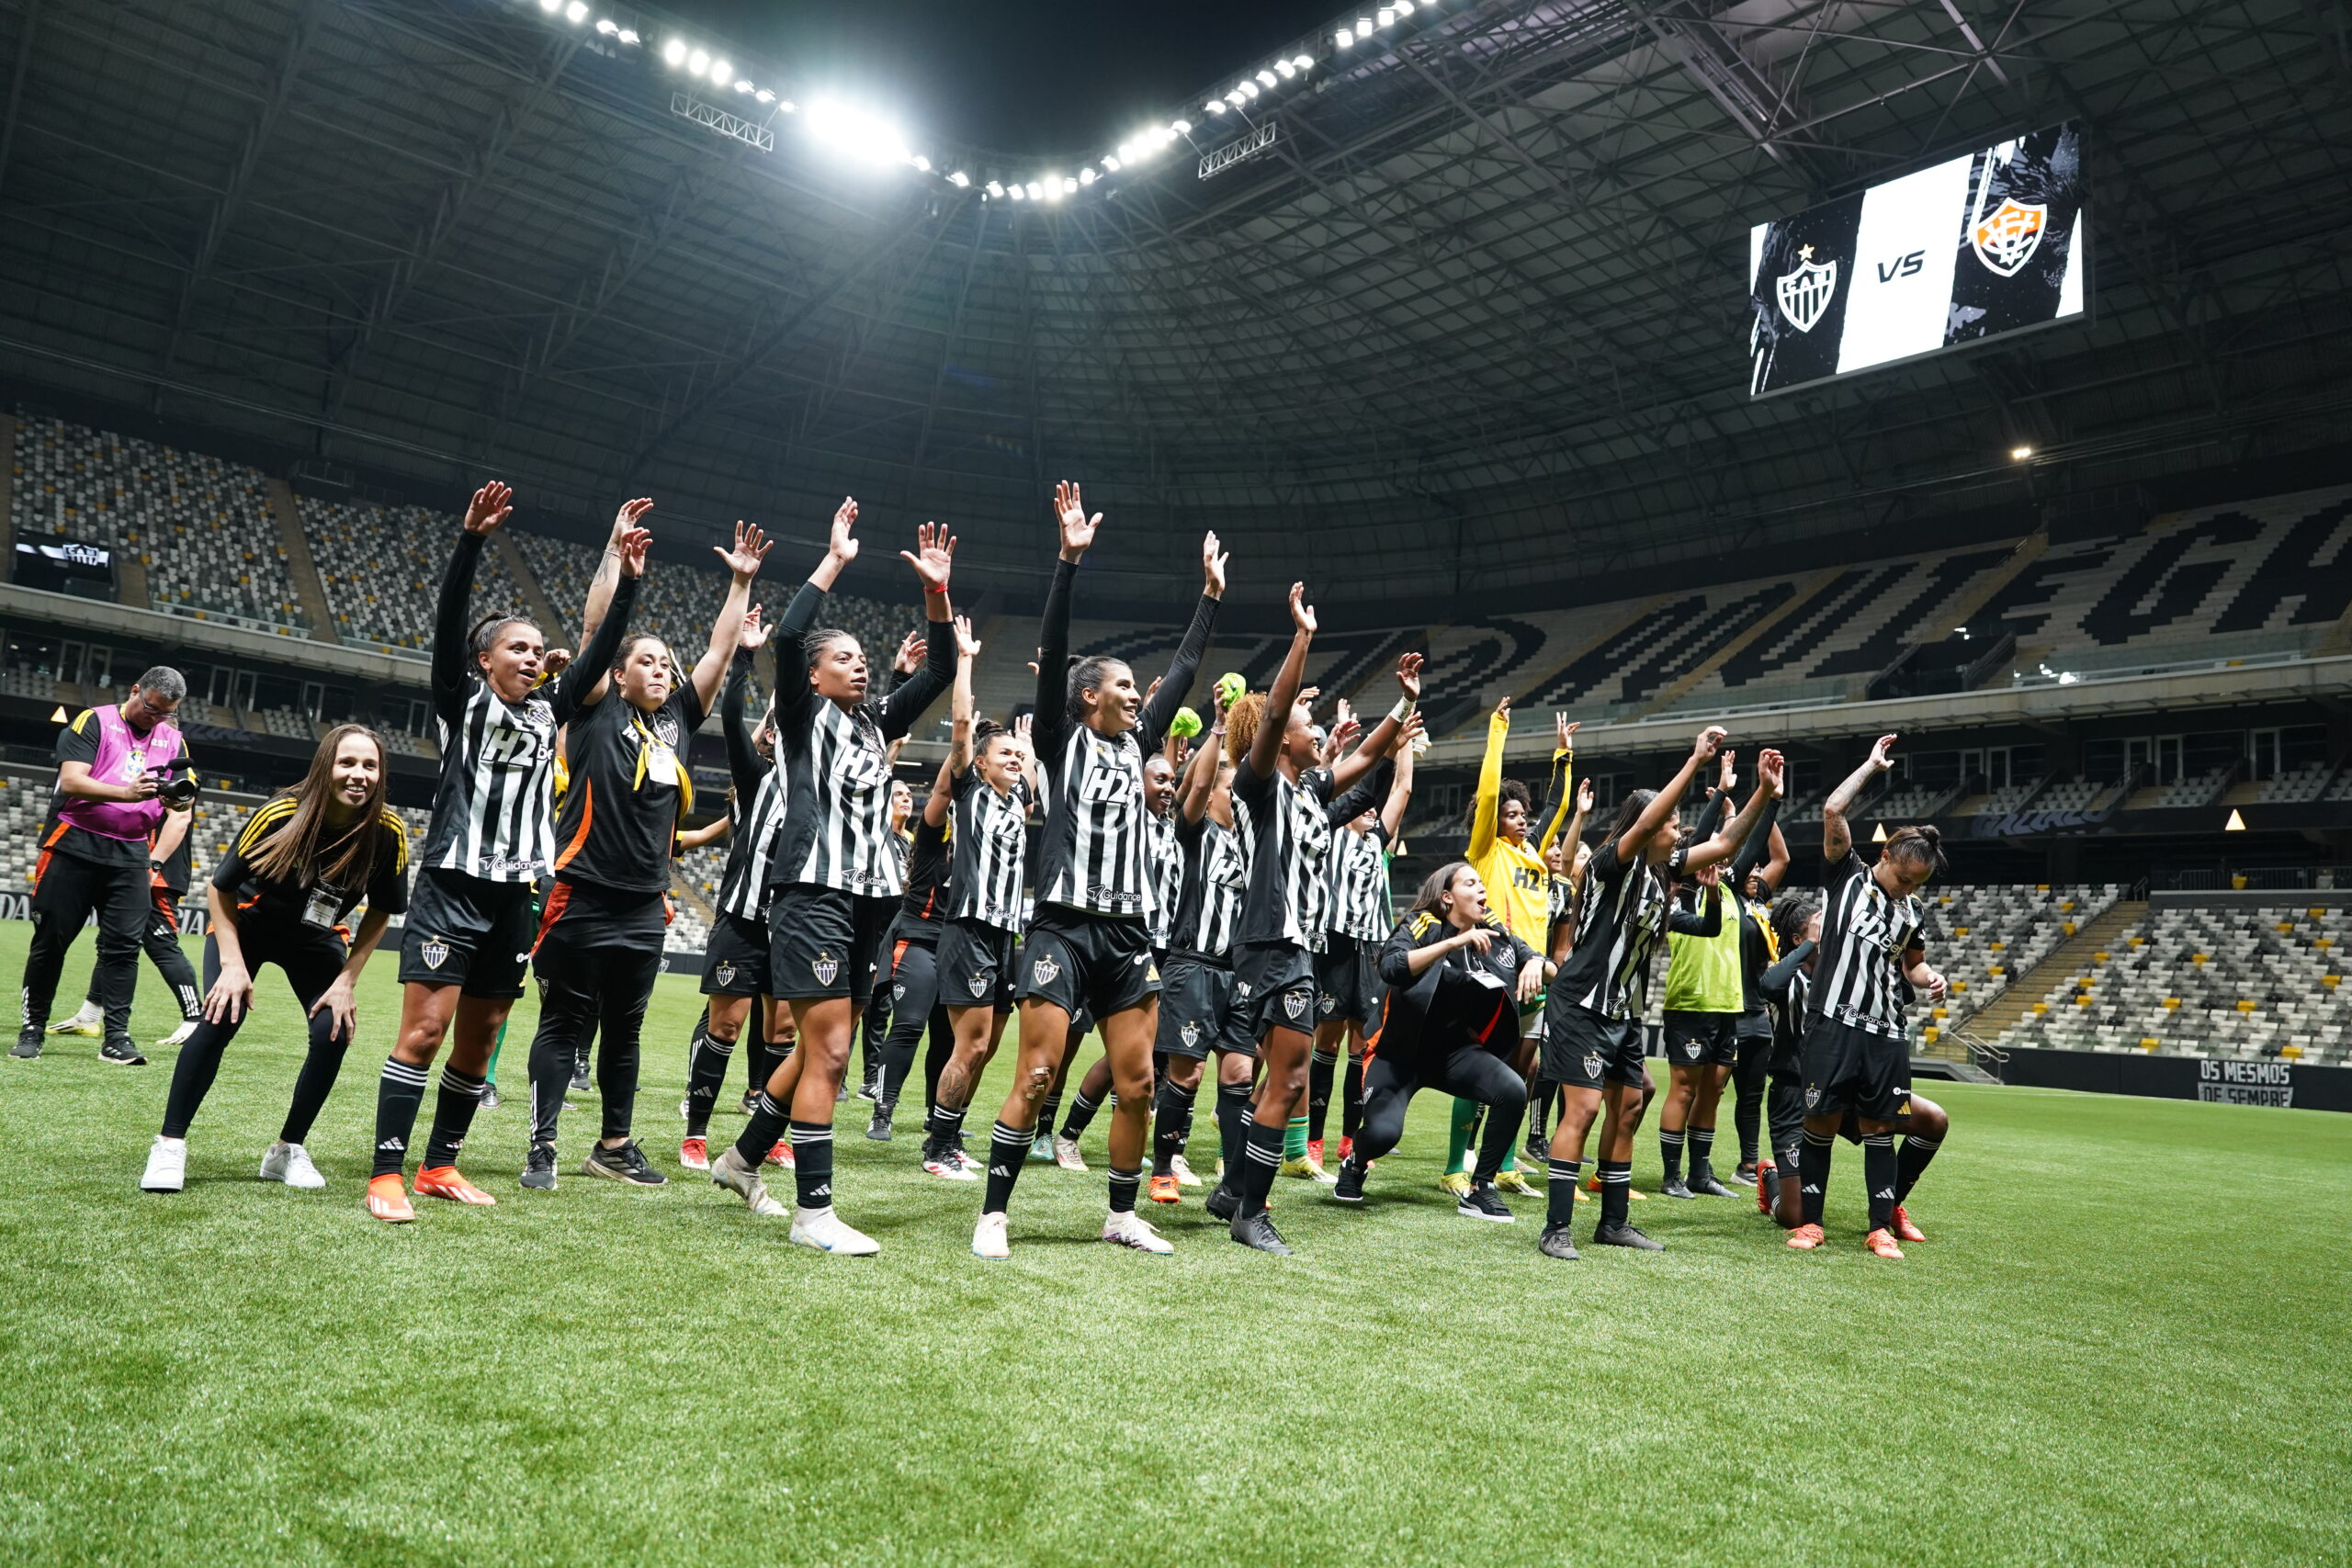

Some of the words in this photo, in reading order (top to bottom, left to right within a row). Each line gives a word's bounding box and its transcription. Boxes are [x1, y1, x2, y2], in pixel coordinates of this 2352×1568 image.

[1877, 250, 1925, 283] VS
[1786, 272, 1826, 292] CAM
[495, 859, 546, 871] Guidance
[1102, 889, 1141, 902] Guidance
[1849, 1009, 1890, 1028] Guidance
[2200, 1060, 2220, 1080] OS
[2224, 1061, 2290, 1085] MESMOS
[2227, 1088, 2290, 1108] SEMPRE
